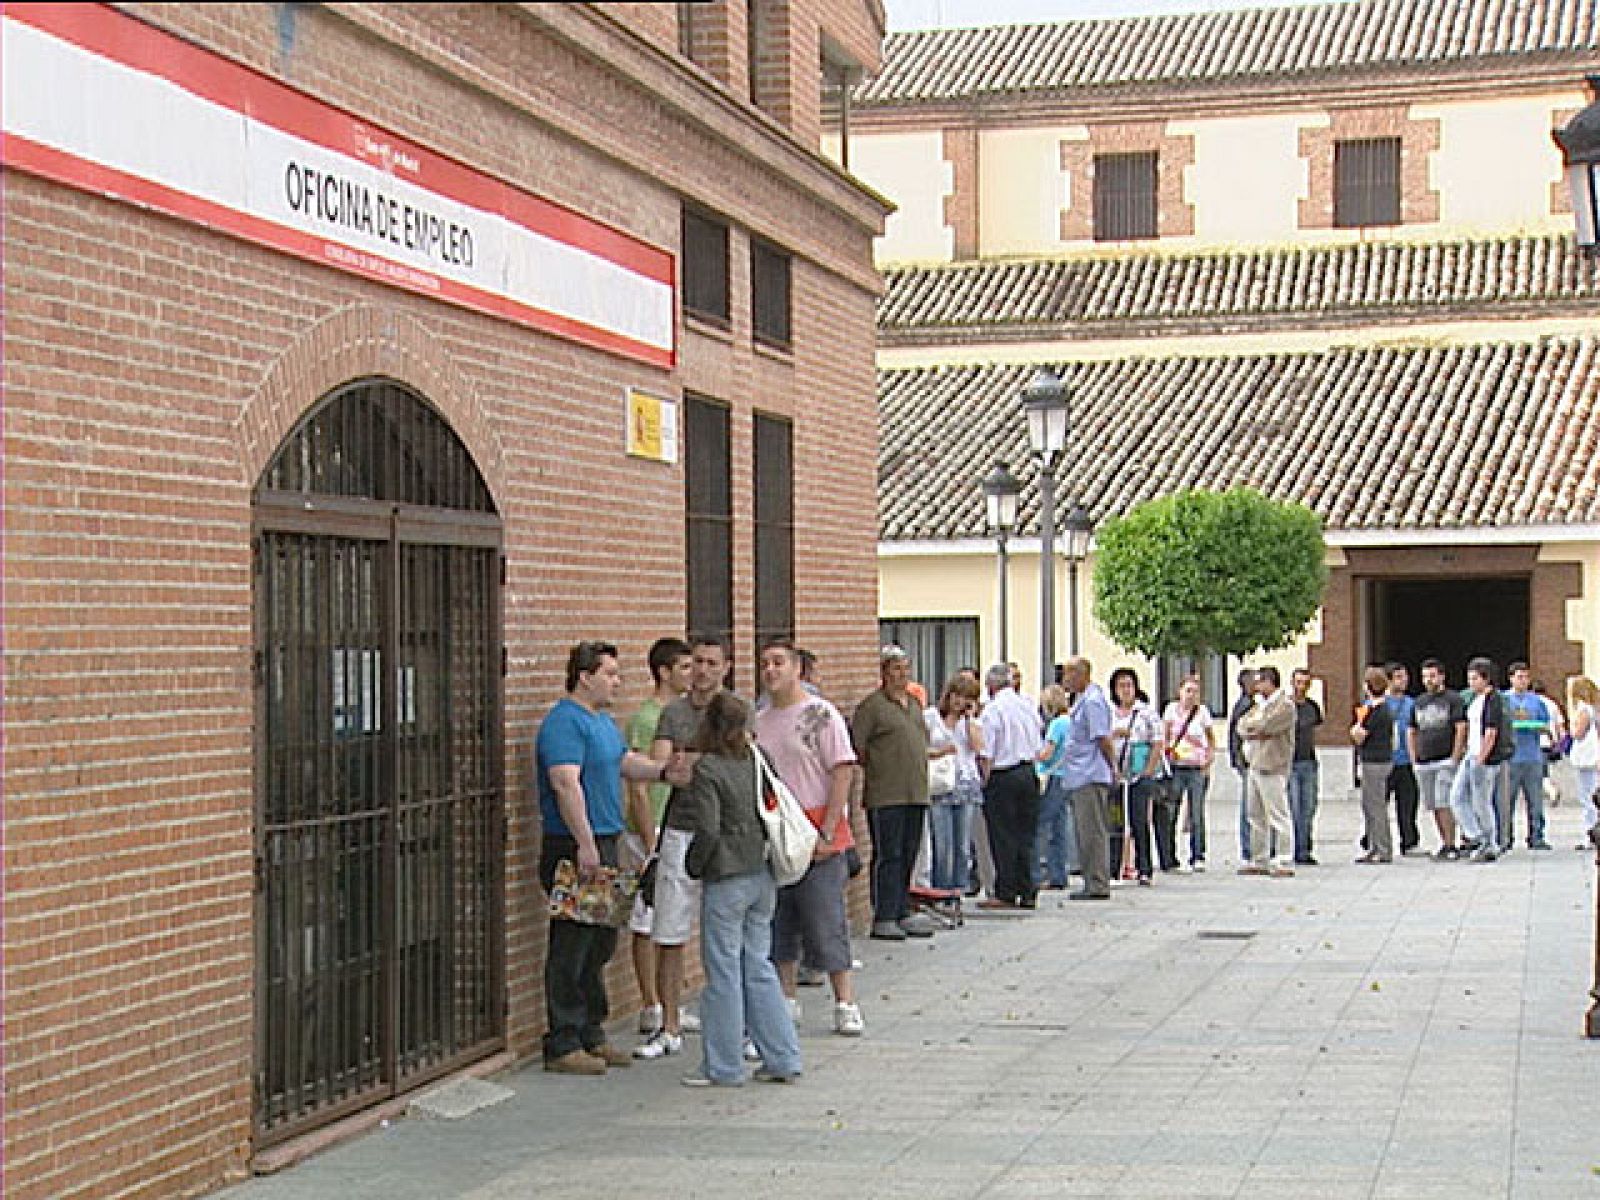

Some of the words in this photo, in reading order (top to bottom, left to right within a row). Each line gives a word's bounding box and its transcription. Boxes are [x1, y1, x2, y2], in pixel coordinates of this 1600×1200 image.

[285, 162, 373, 235] OFICINA
[377, 194, 400, 245] DE
[404, 205, 473, 268] EMPLEO
